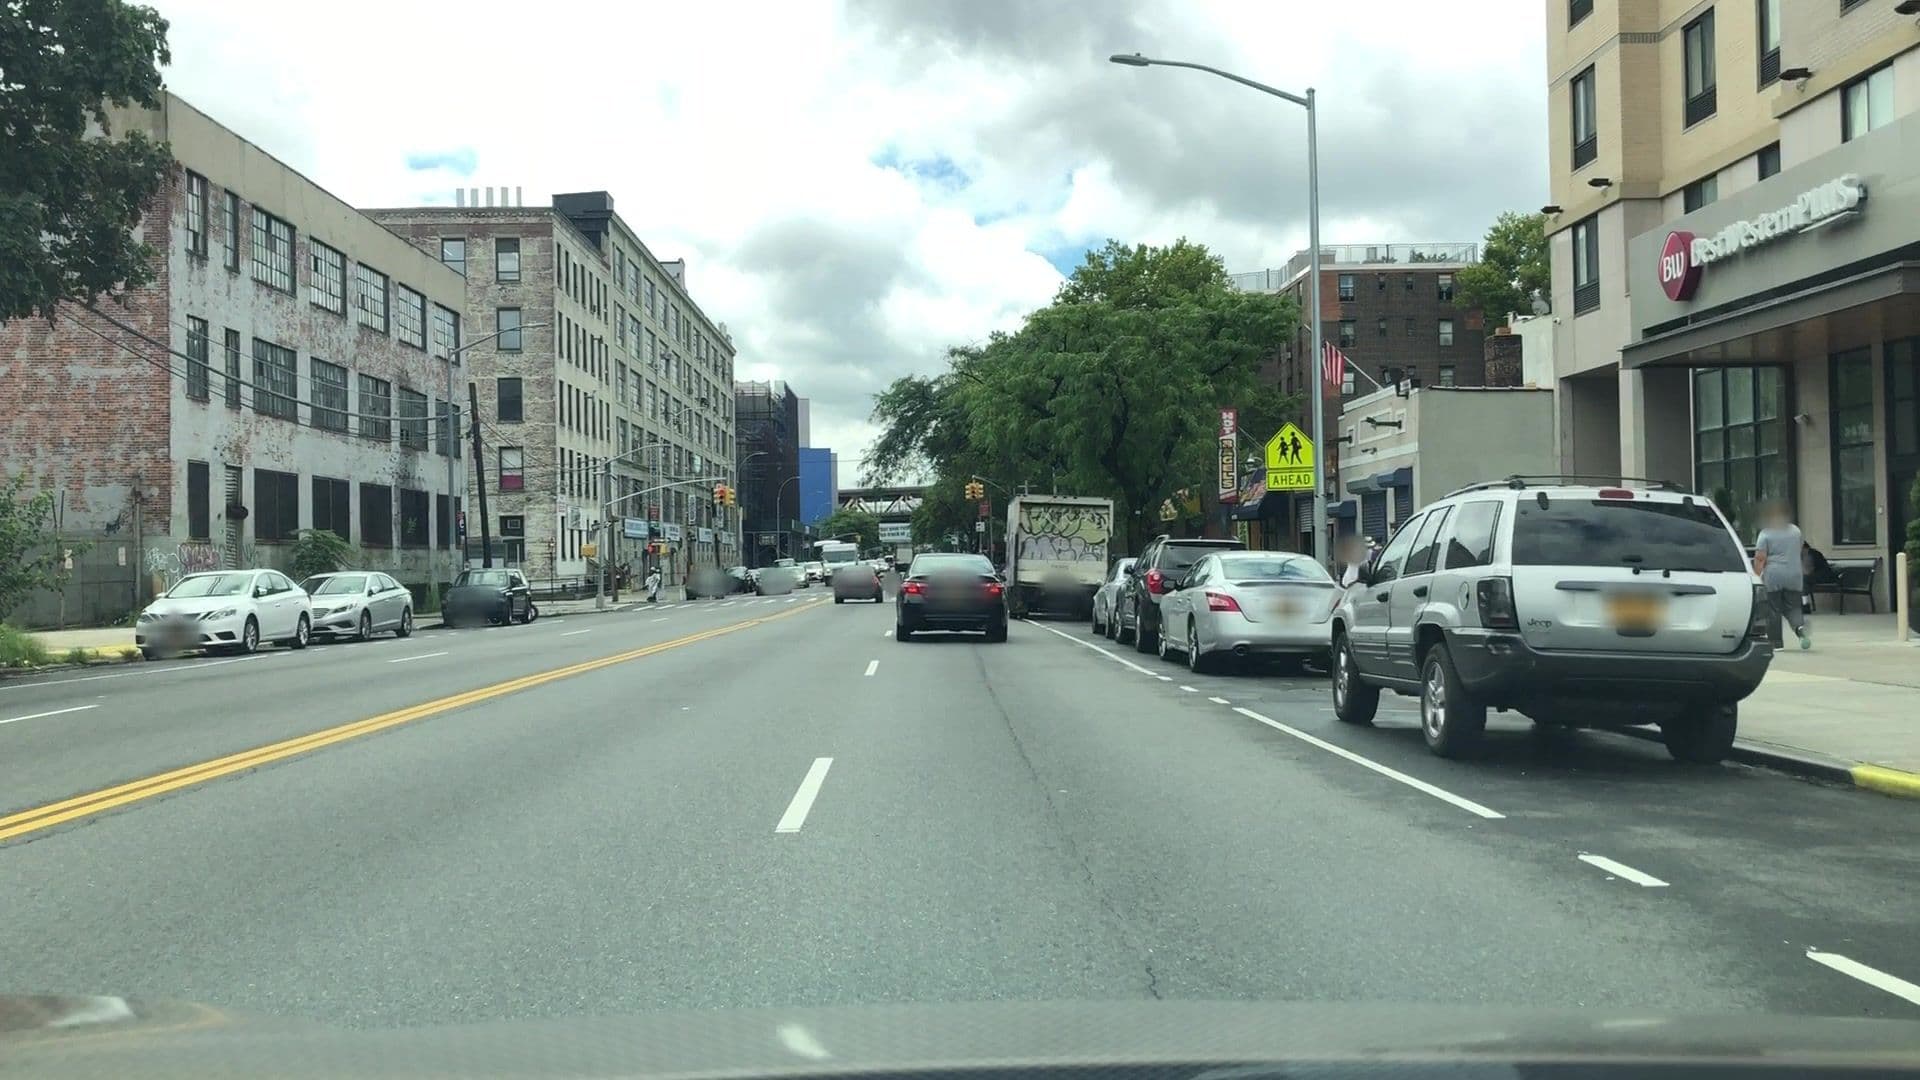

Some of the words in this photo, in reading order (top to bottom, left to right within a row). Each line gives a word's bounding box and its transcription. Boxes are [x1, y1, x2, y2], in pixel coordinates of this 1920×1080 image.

[1691, 230, 1727, 267] Best
[1725, 205, 1807, 254] Western
[1662, 251, 1685, 282] BW
[1221, 411, 1235, 434] HOT
[1272, 474, 1311, 486] AHEAD
[1527, 618, 1552, 629] Jeep
